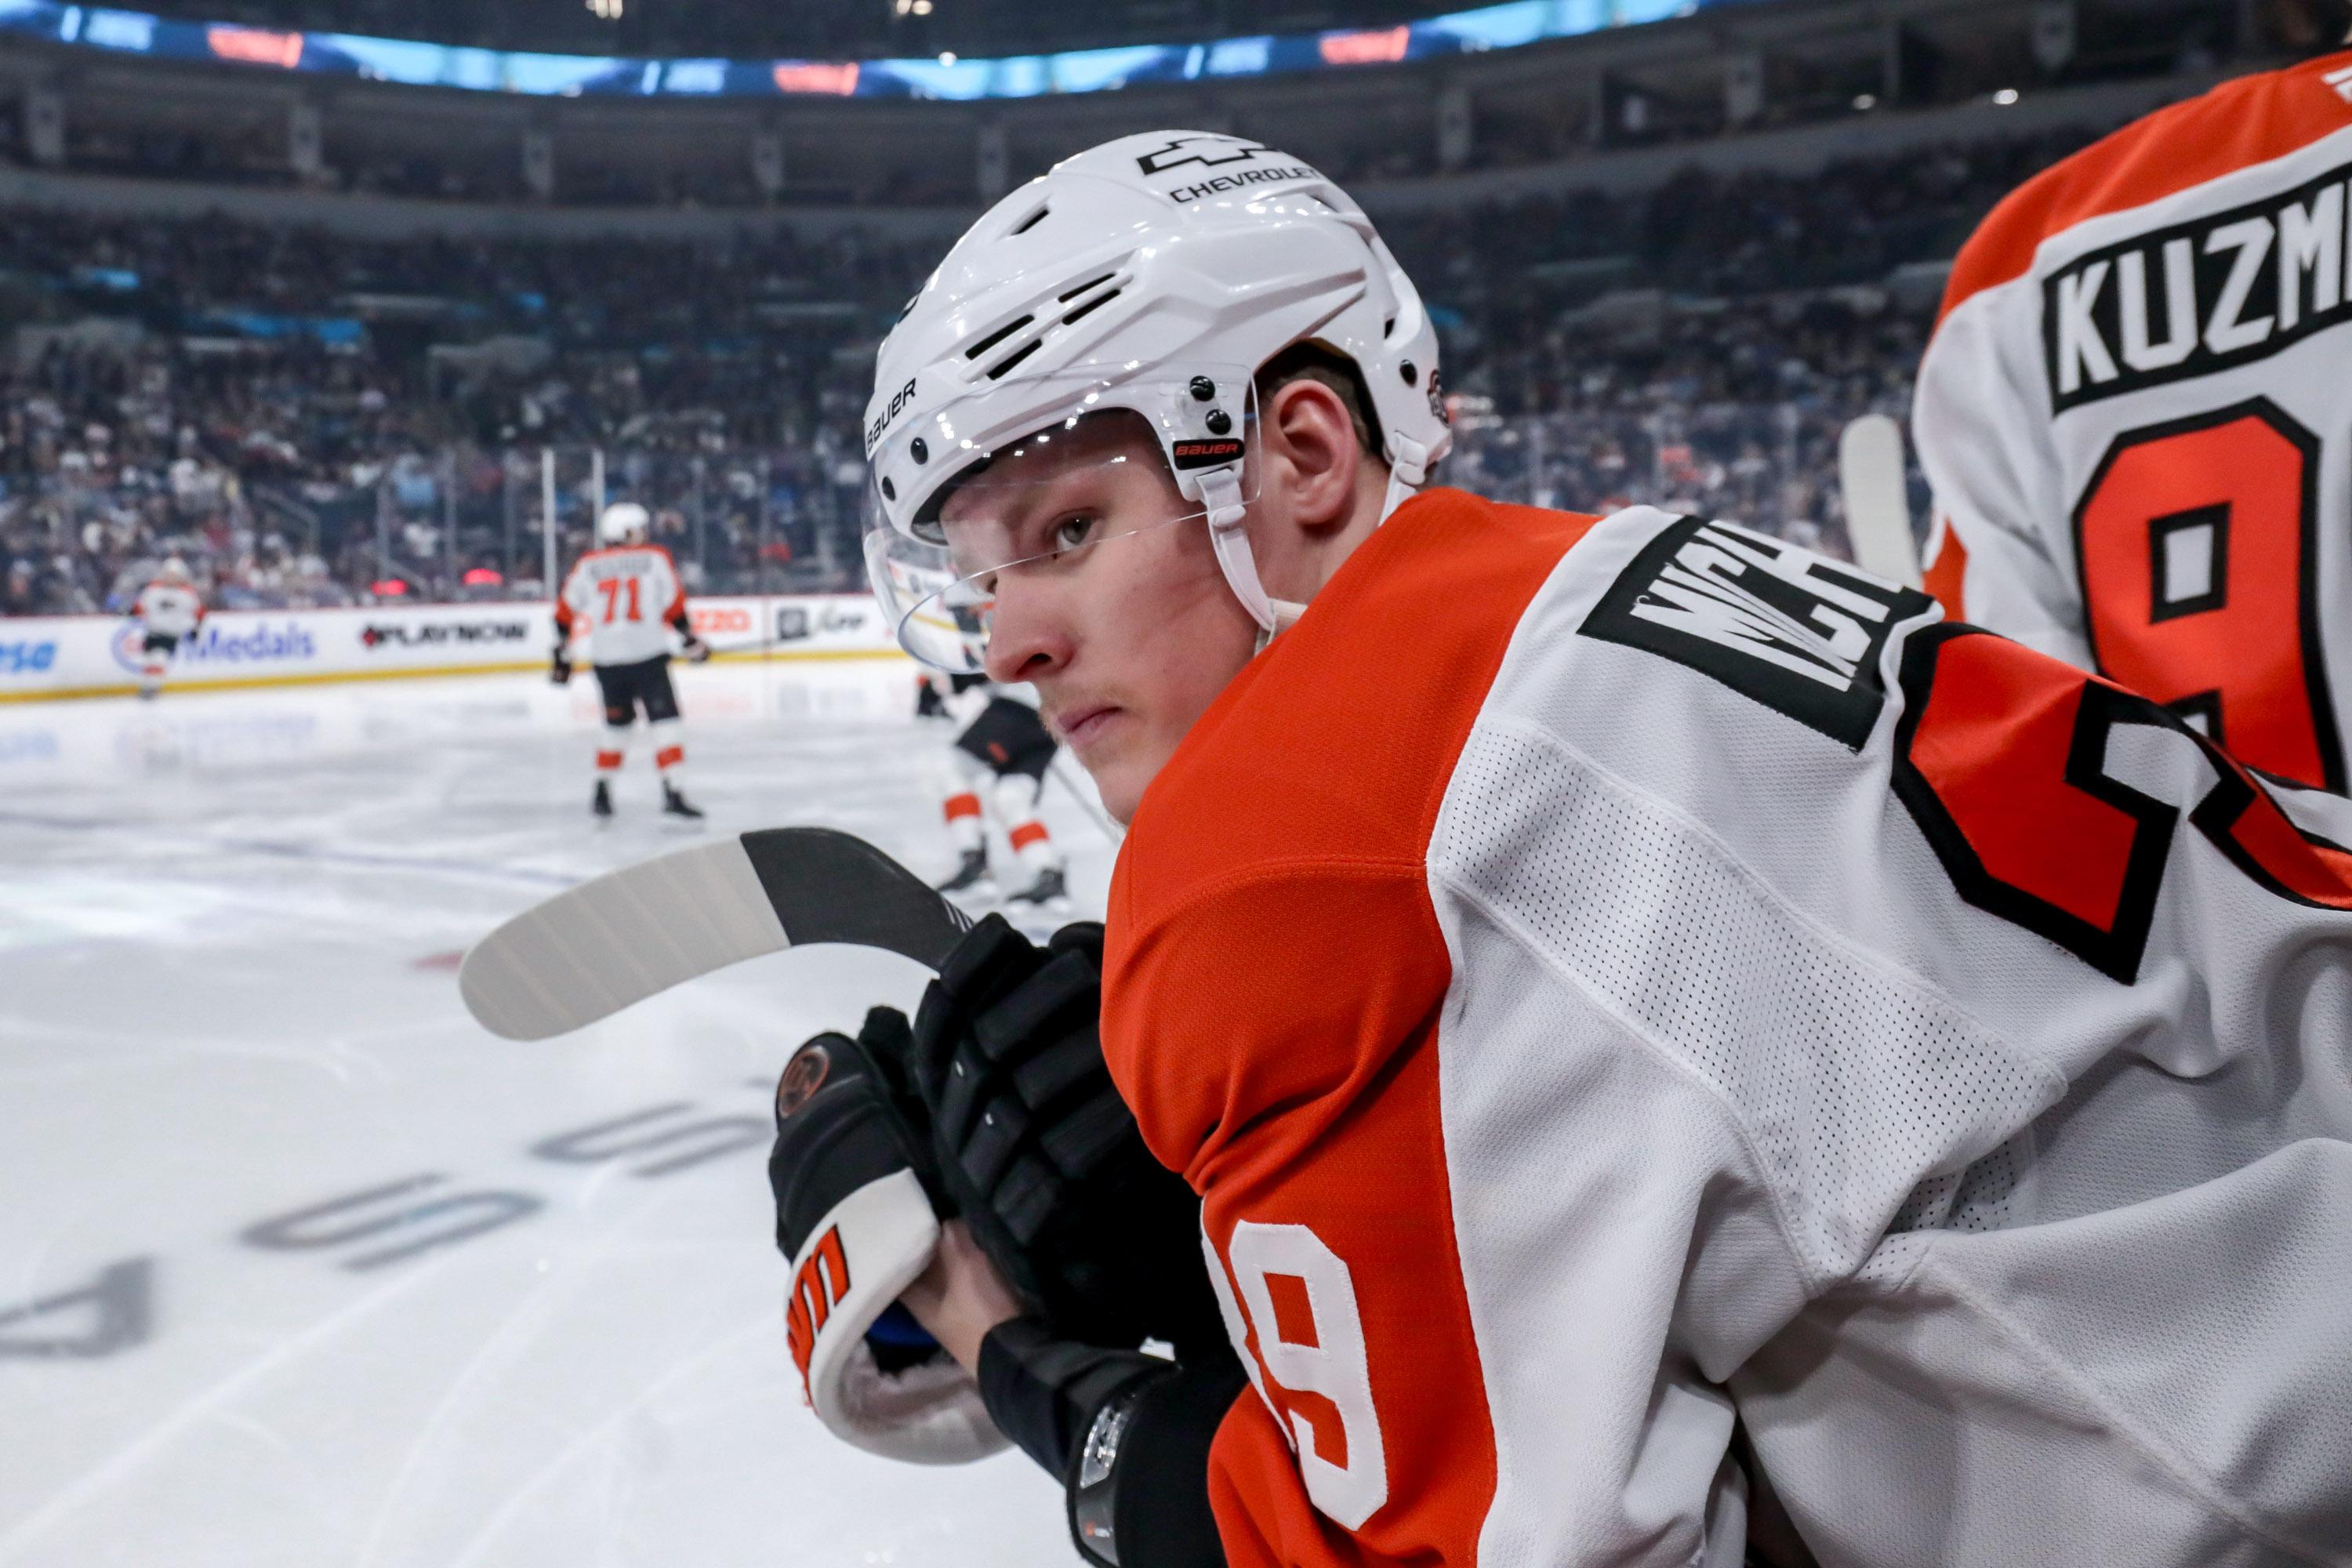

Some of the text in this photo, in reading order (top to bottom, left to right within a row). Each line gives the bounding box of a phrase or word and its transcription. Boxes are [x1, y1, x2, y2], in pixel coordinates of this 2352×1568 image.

[1175, 443, 1239, 456] BAUER
[597, 576, 642, 625] 71
[2071, 394, 2352, 798] 9
